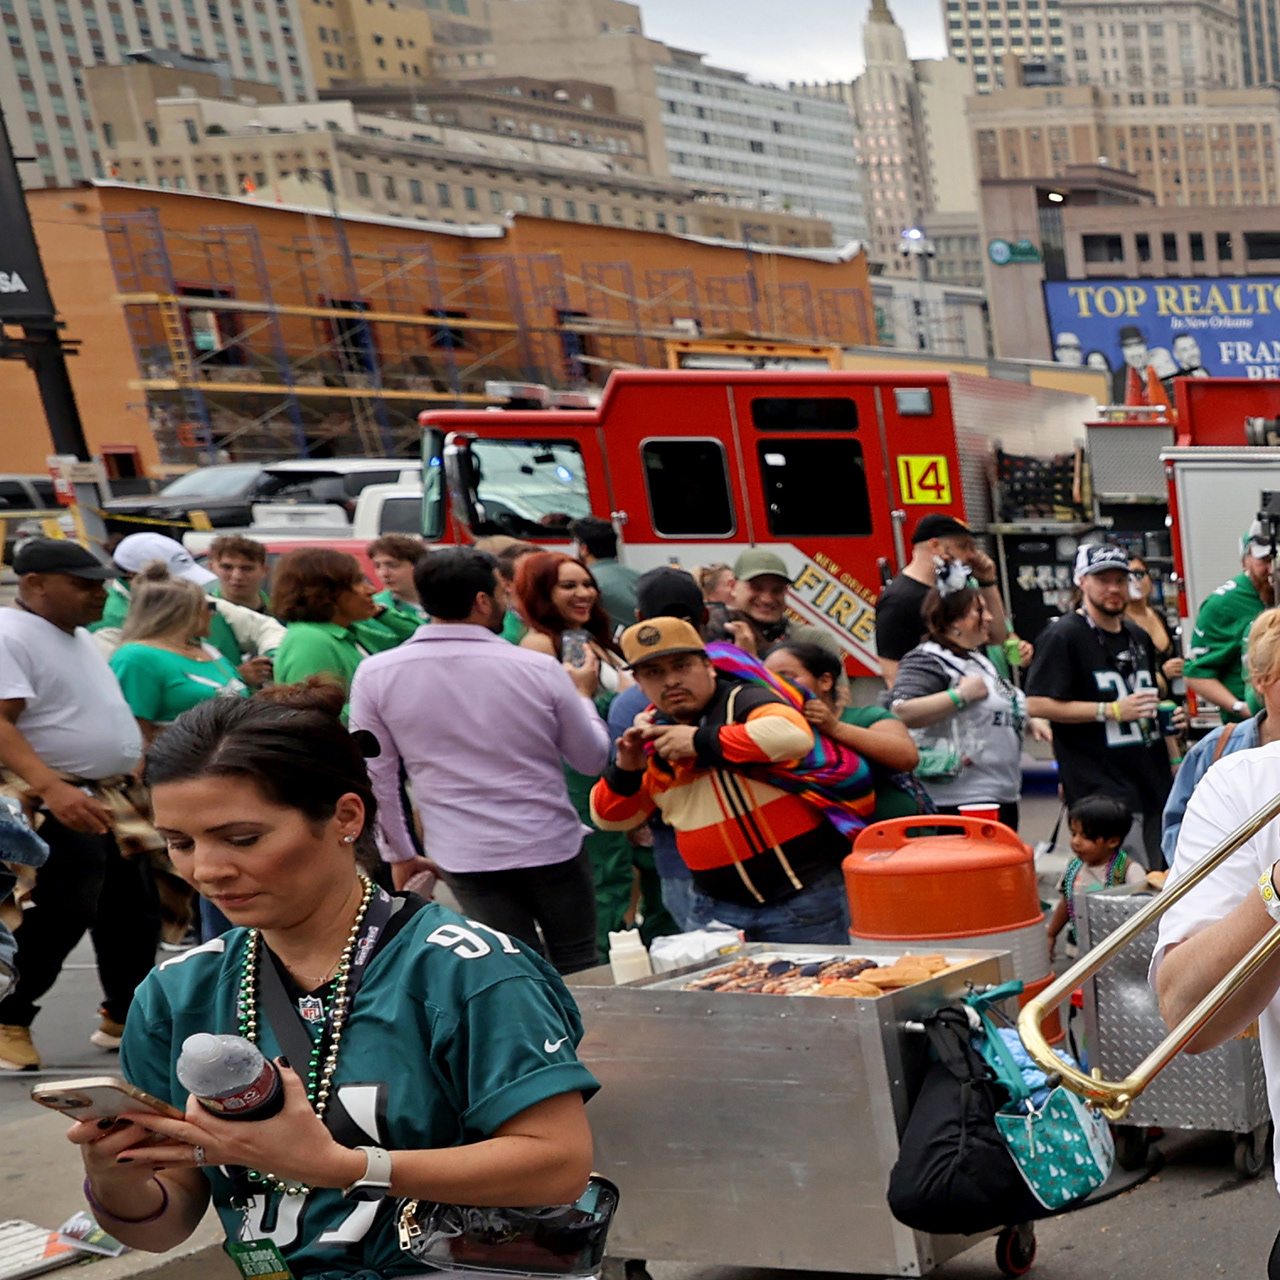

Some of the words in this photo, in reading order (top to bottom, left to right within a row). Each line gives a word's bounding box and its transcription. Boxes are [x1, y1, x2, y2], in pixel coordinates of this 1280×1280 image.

[1068, 285, 1148, 318] TOP
[1186, 317, 1208, 328] New
[903, 460, 945, 500] 14
[813, 551, 842, 576] NEW
[840, 571, 879, 605] ORLEA
[793, 563, 877, 643] FIRE
[303, 1008, 321, 1020] NFL
